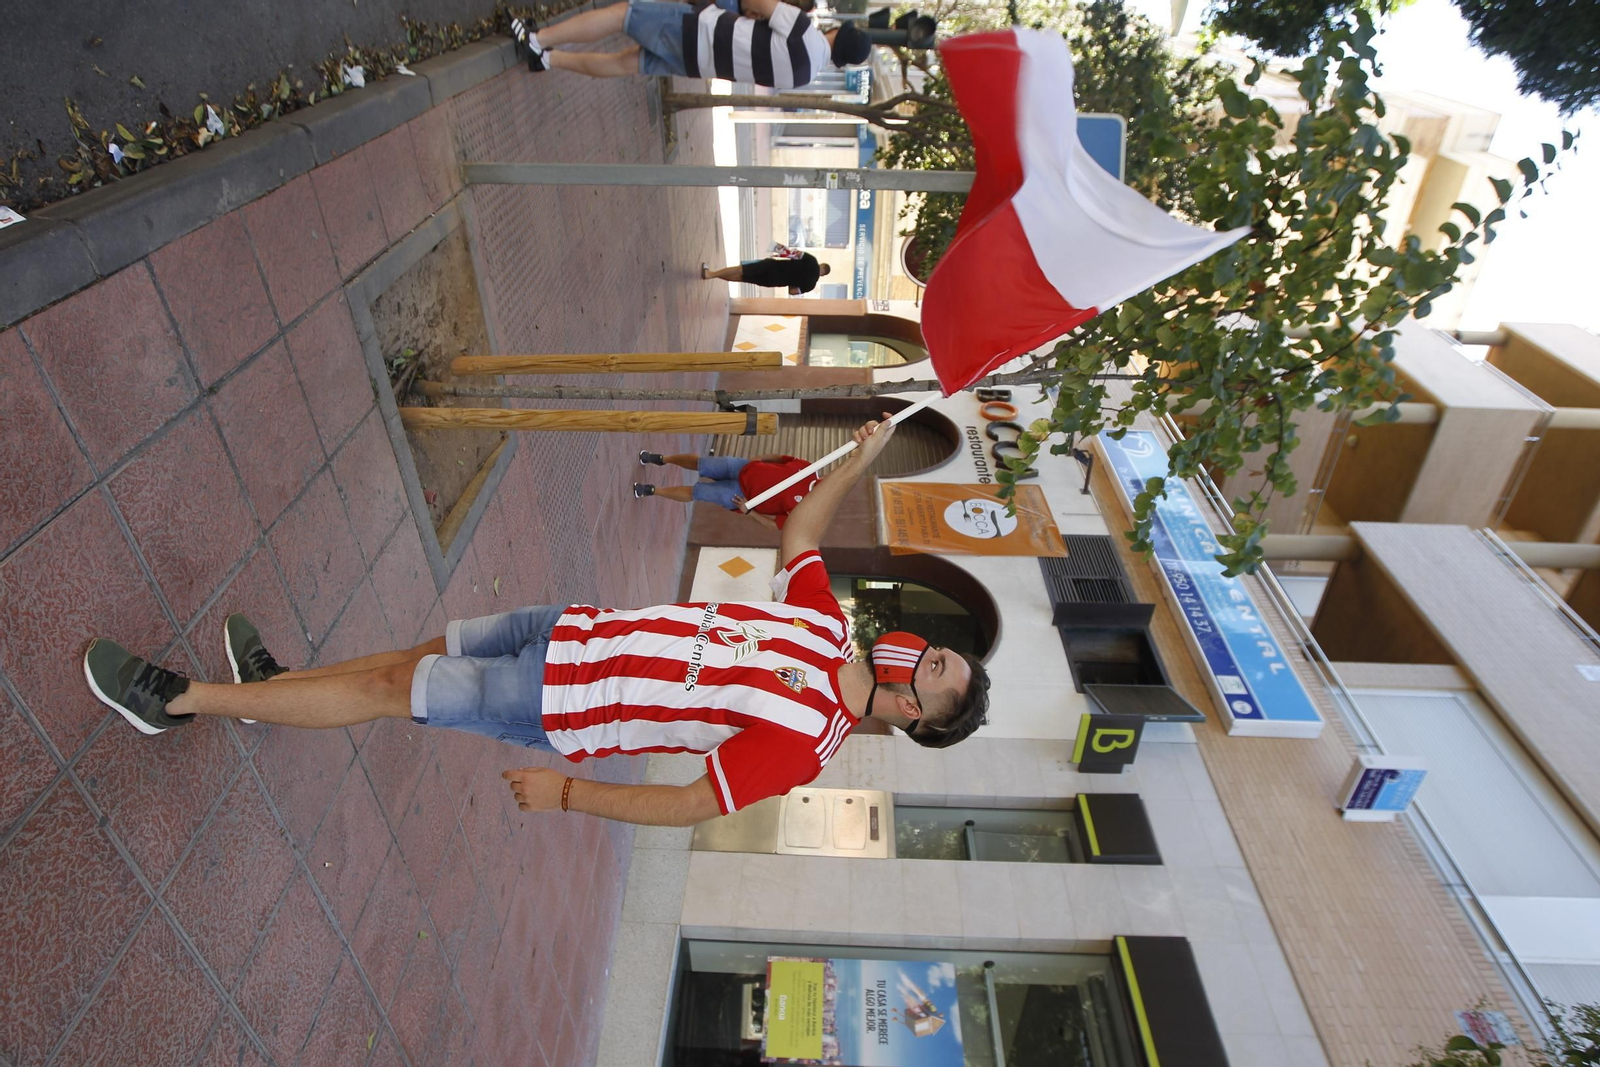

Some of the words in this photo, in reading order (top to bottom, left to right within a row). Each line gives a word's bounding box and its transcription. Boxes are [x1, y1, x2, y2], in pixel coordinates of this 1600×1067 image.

[858, 224, 866, 254] SERVICIO
[858, 256, 864, 264] DE
[966, 426, 993, 484] restaurante
[916, 504, 926, 524] ABIERTO
[927, 504, 940, 539] RESTAURANTE
[970, 503, 990, 535] BOCCA
[920, 526, 929, 538] PARA
[1180, 593, 1197, 603] 14
[698, 602, 718, 632] rabia
[1187, 607, 1204, 617] 14
[1193, 620, 1212, 633] 37
[685, 634, 709, 692] Centres
[1092, 728, 1135, 753] B
[877, 980, 886, 988] TU
[866, 989, 875, 1006] ALGO
[877, 990, 887, 1007] CASA
[866, 1008, 876, 1034] MEJOR.
[878, 1009, 887, 1017] SE
[878, 1018, 888, 1045] MERECE
